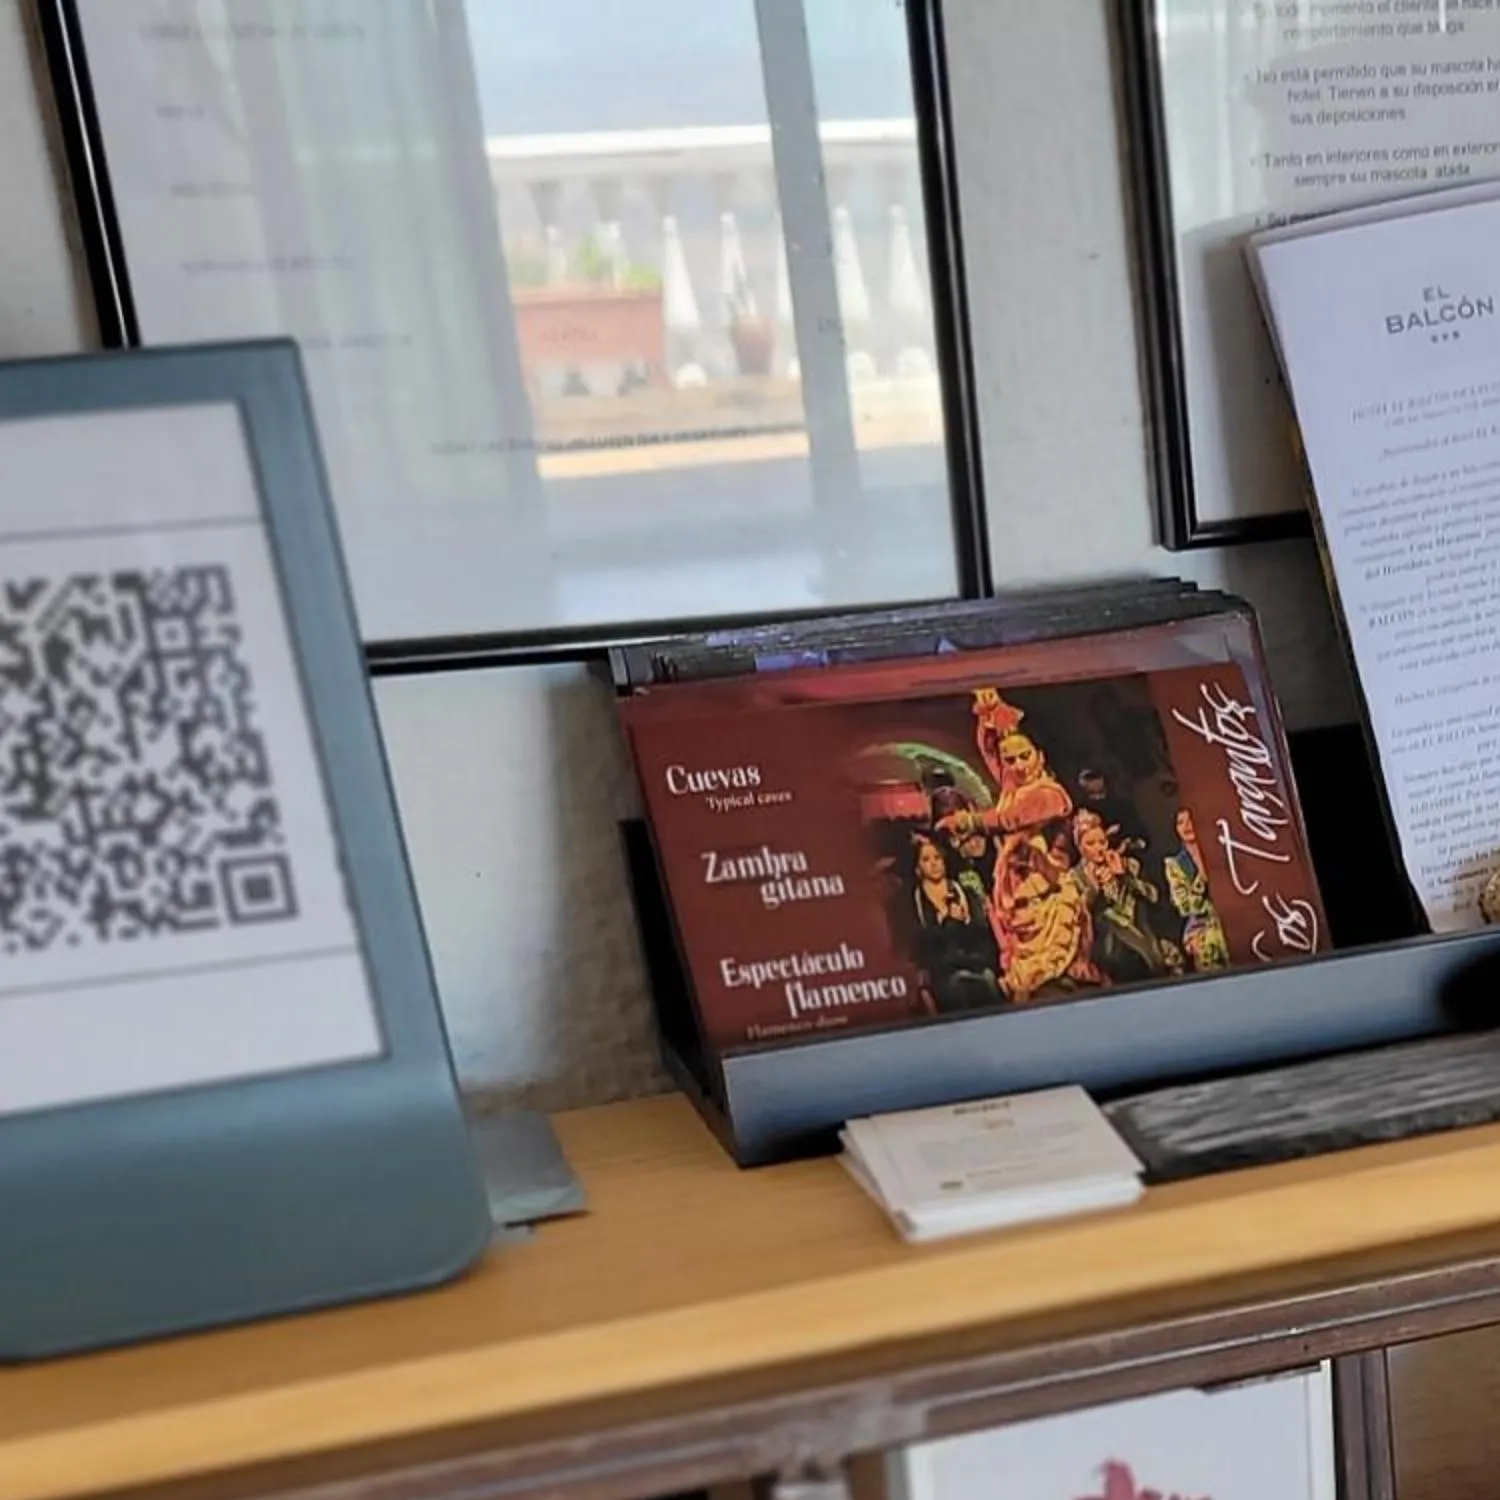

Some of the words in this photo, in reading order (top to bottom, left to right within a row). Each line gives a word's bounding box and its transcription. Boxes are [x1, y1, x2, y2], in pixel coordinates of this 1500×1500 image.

[1313, 64, 1378, 84] permitido
[1380, 64, 1407, 79] que
[1411, 64, 1427, 76] su
[1430, 60, 1484, 76] mascota
[1328, 84, 1376, 100] Tienen
[1379, 88, 1389, 98] a
[1393, 86, 1409, 98] su
[1487, 80, 1499, 93] el
[1289, 112, 1313, 125] sus
[1263, 151, 1302, 168] Tanto
[1305, 153, 1324, 166] en
[1326, 148, 1389, 164] interiores
[1392, 146, 1430, 160] como
[1433, 145, 1449, 157] en
[1293, 172, 1346, 188] siempre
[1350, 172, 1367, 183] su
[1370, 166, 1427, 182] mascota
[1423, 284, 1450, 302] EL
[1386, 294, 1495, 335] BALCÓN
[666, 764, 762, 796] Cuevas
[705, 792, 755, 814] Typical
[757, 789, 792, 806] caves
[701, 845, 808, 884] Zambra
[759, 873, 846, 910] gitana
[719, 942, 864, 989] Espectáculo
[785, 973, 907, 1019] flamenco
